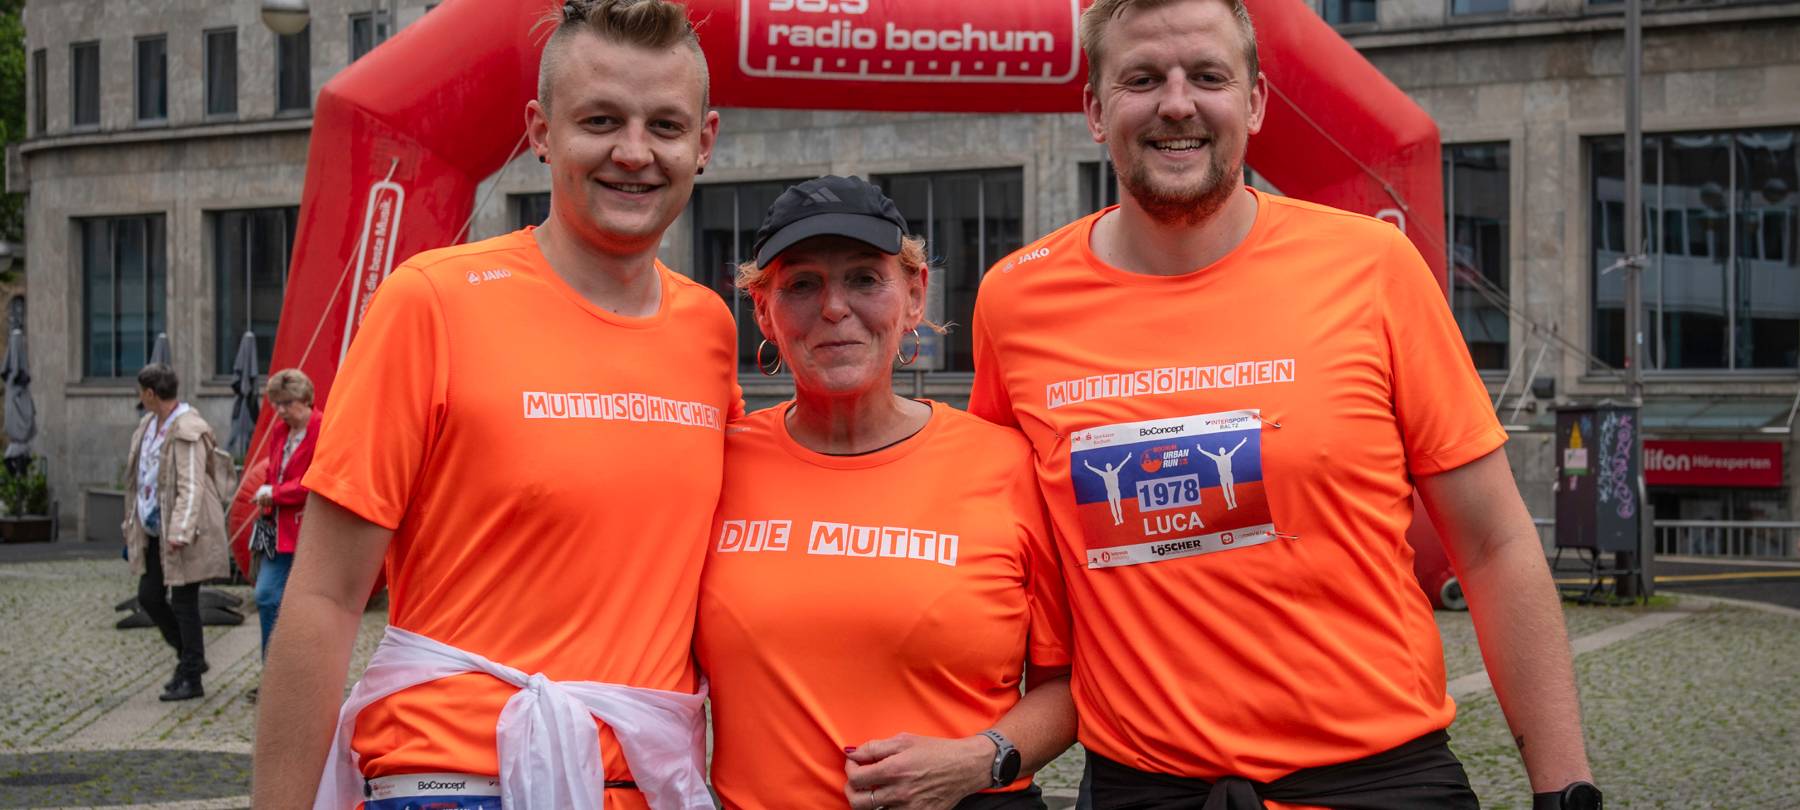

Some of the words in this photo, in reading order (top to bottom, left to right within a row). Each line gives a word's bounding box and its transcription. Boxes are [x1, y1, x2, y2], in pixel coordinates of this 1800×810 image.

[768, 20, 877, 50] radio
[885, 23, 1054, 52] bochum
[368, 238, 385, 272] beste
[1017, 247, 1050, 265] JAKO
[365, 271, 379, 292] die
[482, 269, 512, 281] JAKO
[1046, 358, 1295, 409] MUTTISÖHNCHEN
[523, 391, 720, 430] MUTTISÖHNCHEN
[1139, 424, 1185, 437] BoConcept
[1162, 458, 1179, 469] RUN
[1163, 449, 1190, 460] URBAN
[1692, 454, 1771, 470] Hörexperten
[1139, 478, 1199, 508] 1978
[1143, 511, 1204, 536] LUCA
[717, 519, 792, 552] DIE
[807, 521, 959, 566] MUTTI
[1151, 539, 1201, 556] LÖSCHER
[417, 780, 466, 791] BoConcept
